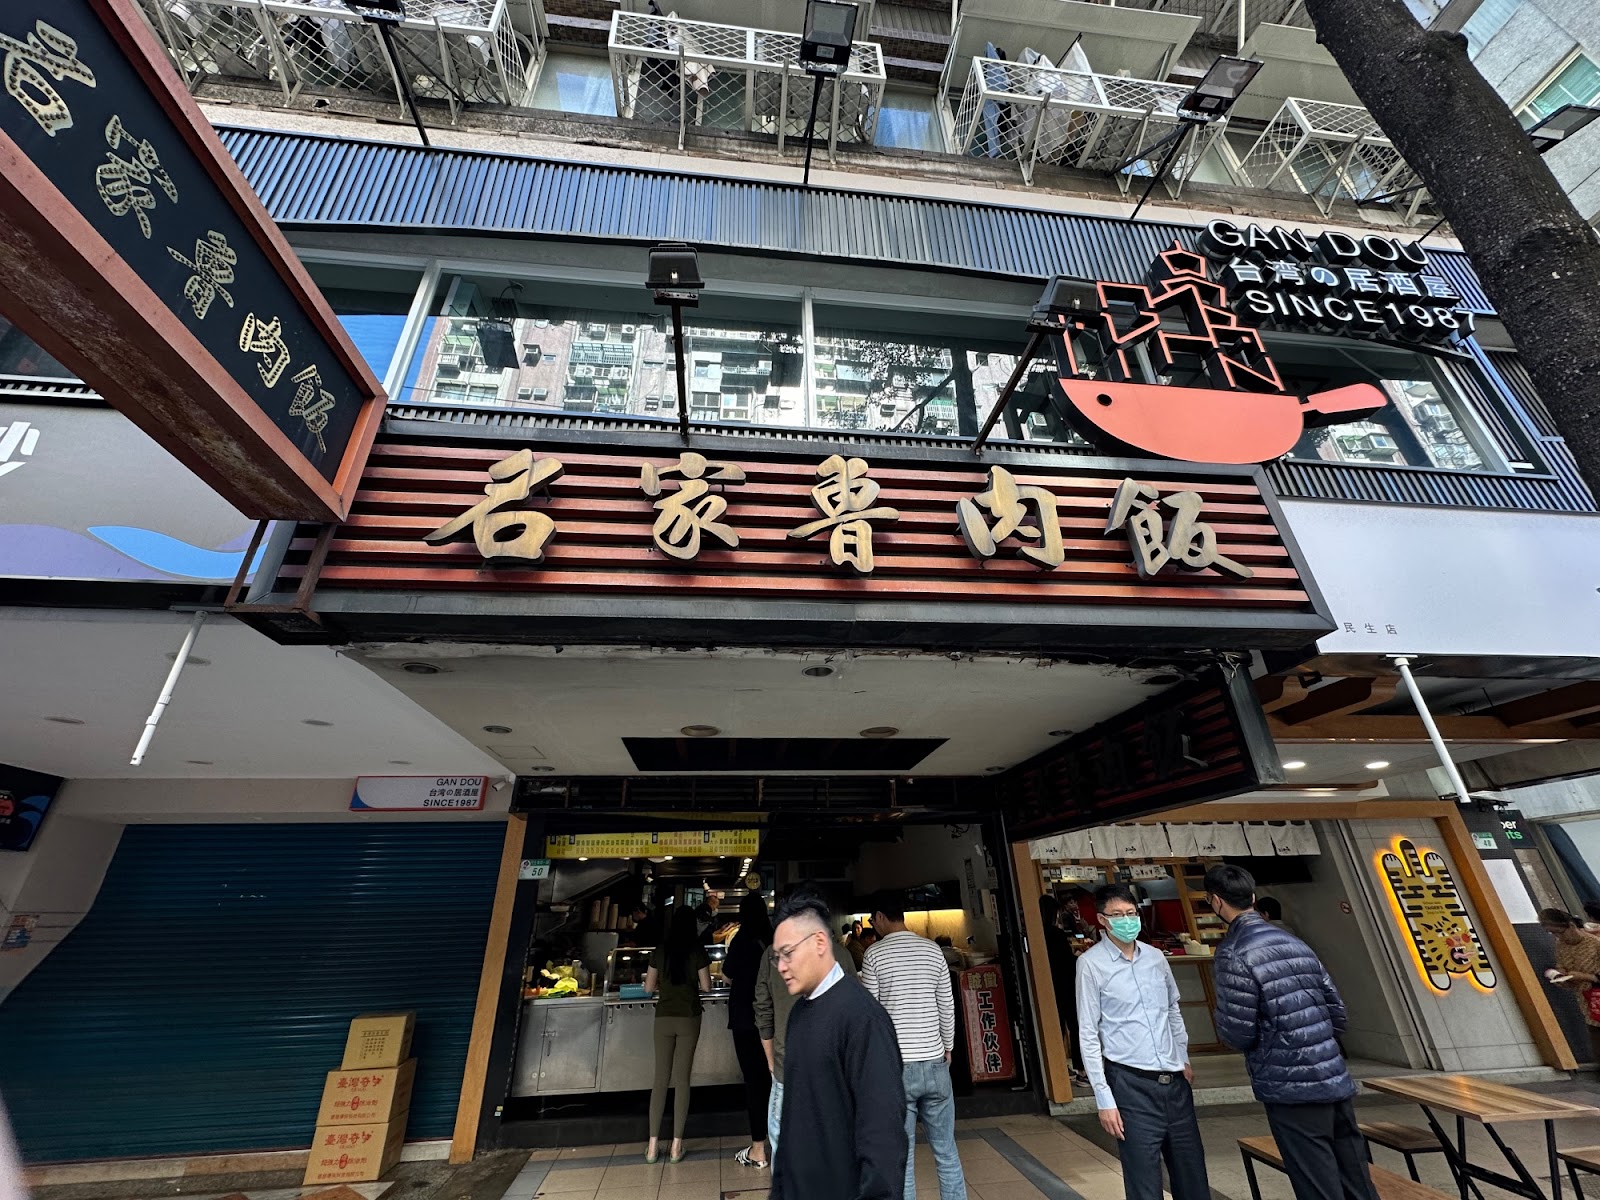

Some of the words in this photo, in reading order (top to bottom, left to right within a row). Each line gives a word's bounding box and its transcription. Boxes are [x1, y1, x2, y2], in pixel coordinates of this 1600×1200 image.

[1207, 219, 1313, 253] GAN
[1322, 231, 1430, 265] DOU
[1231, 257, 1460, 300] 台湾の居酒屋
[1245, 289, 1476, 332] SINCE1987
[1343, 621, 1398, 635] 民生店
[436, 778, 457, 786] GAN
[459, 778, 482, 786] DOU
[429, 788, 480, 797] 台湾の居酒屋
[423, 799, 478, 807] SINCE1987
[531, 867, 543, 876] 50
[978, 991, 1003, 1073] 工作伙伴
